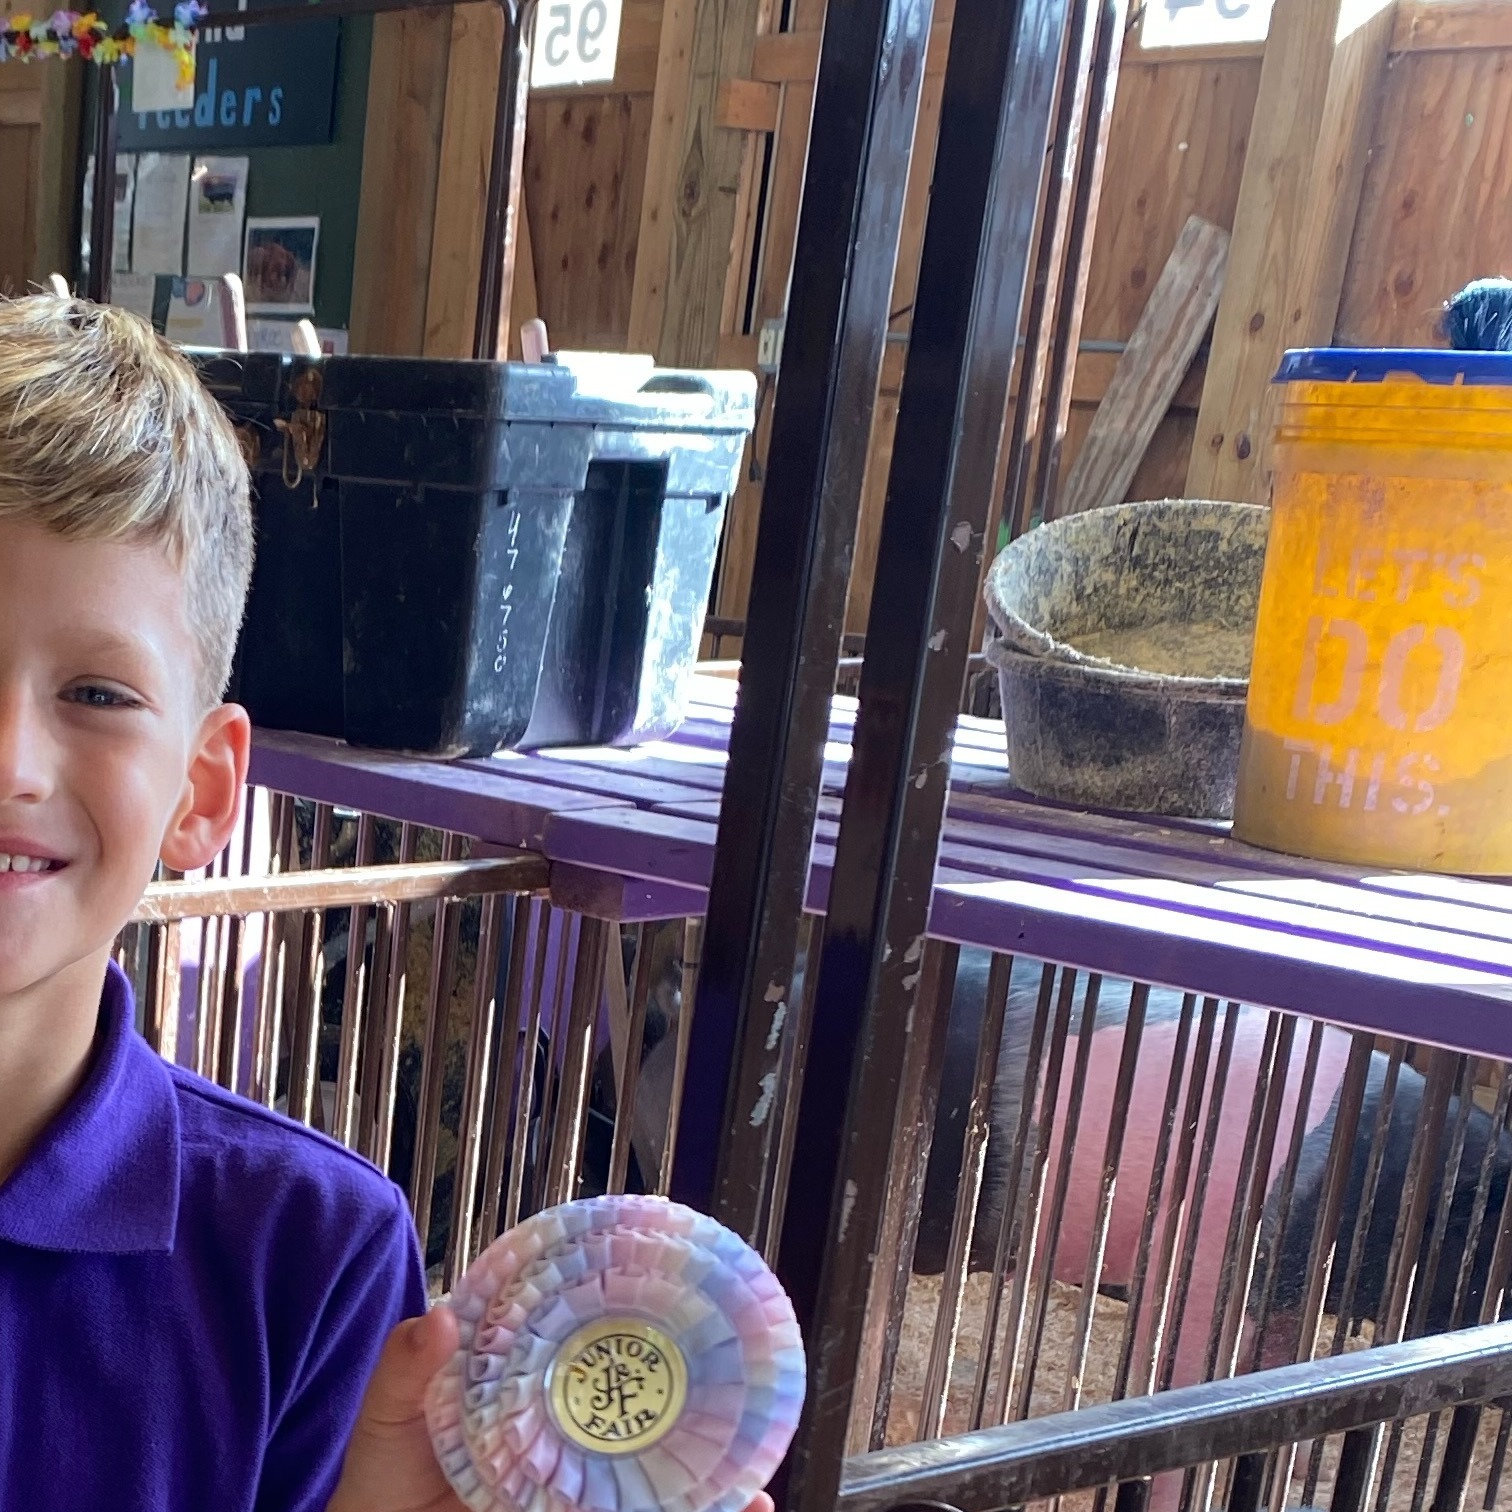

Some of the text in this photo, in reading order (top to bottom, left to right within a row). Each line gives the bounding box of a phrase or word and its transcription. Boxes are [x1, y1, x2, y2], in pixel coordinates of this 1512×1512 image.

[1312, 540, 1487, 609] LET'S
[1292, 615, 1465, 733] DO
[1284, 736, 1451, 817] THIS.
[568, 1338, 660, 1383] JUNIOR
[584, 1408, 658, 1437] FAIR
